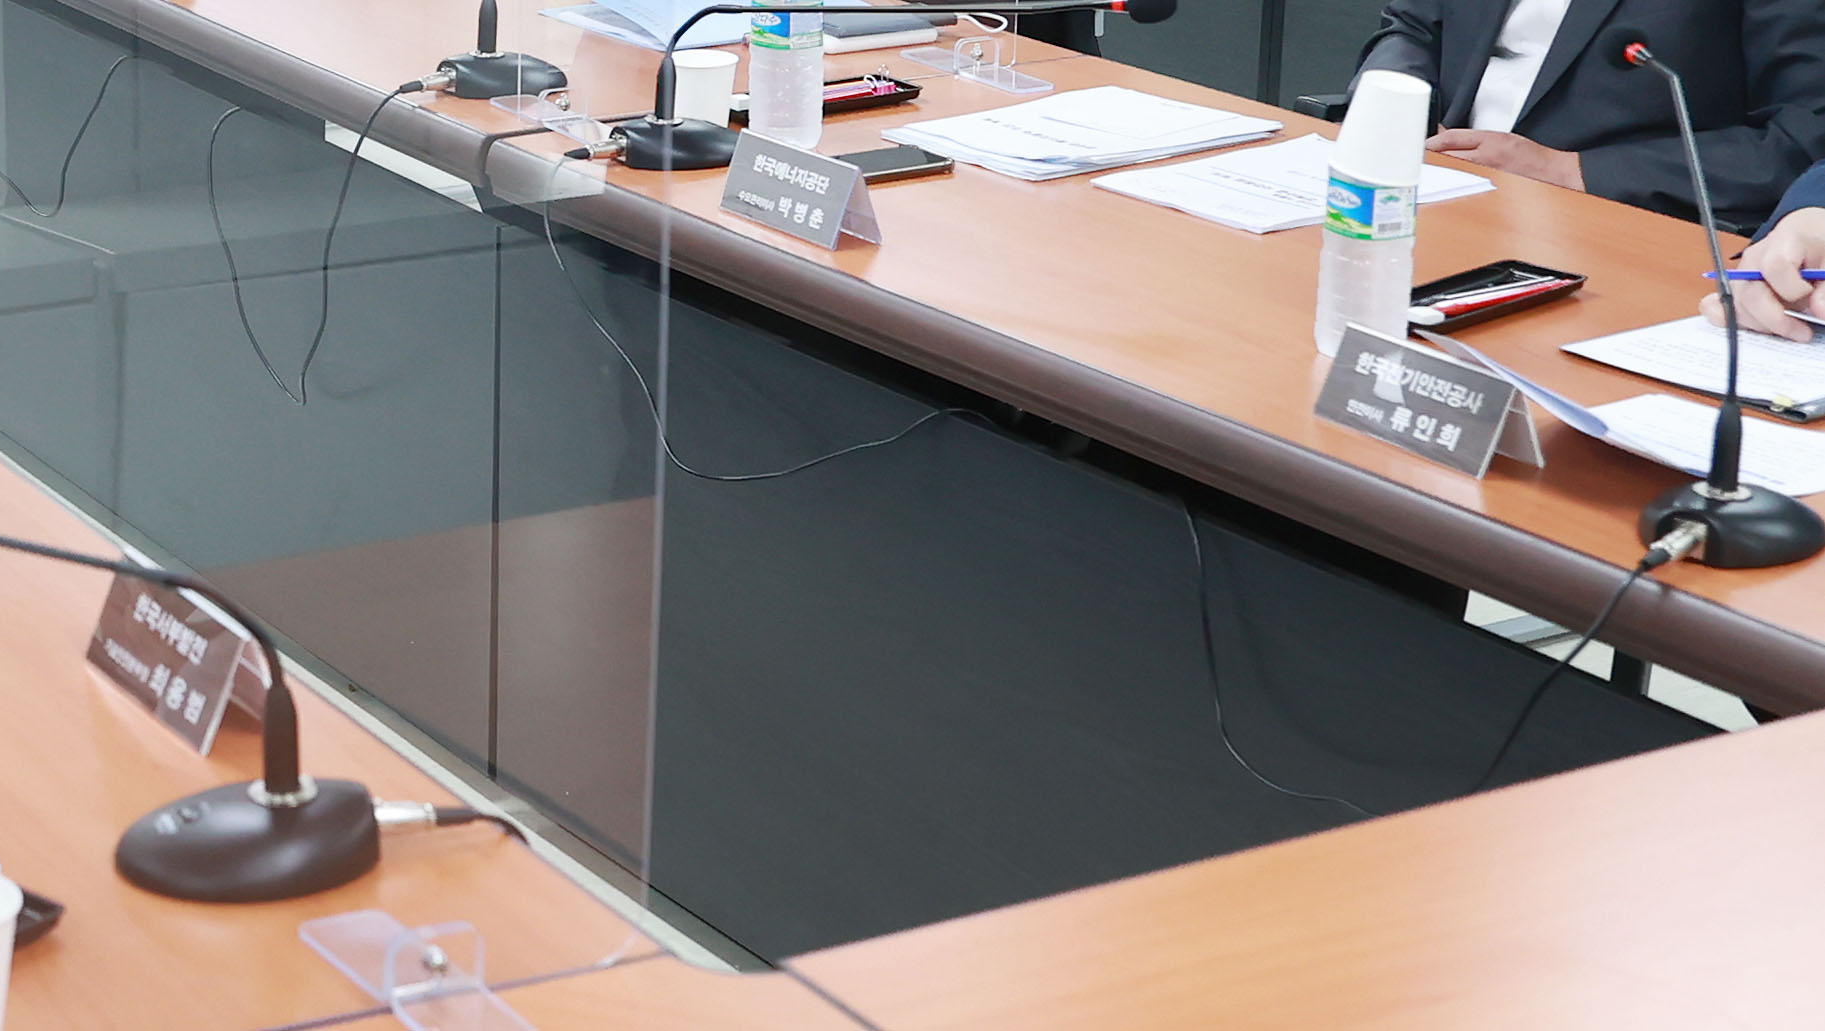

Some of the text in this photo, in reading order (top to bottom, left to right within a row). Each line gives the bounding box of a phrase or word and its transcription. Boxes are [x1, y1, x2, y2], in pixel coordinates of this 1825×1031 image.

[753, 153, 831, 195] 한국에너지공단
[778, 196, 825, 230] 박병춘
[1354, 351, 1486, 415] 한국전기안전공사
[1390, 405, 1463, 453] 류인희
